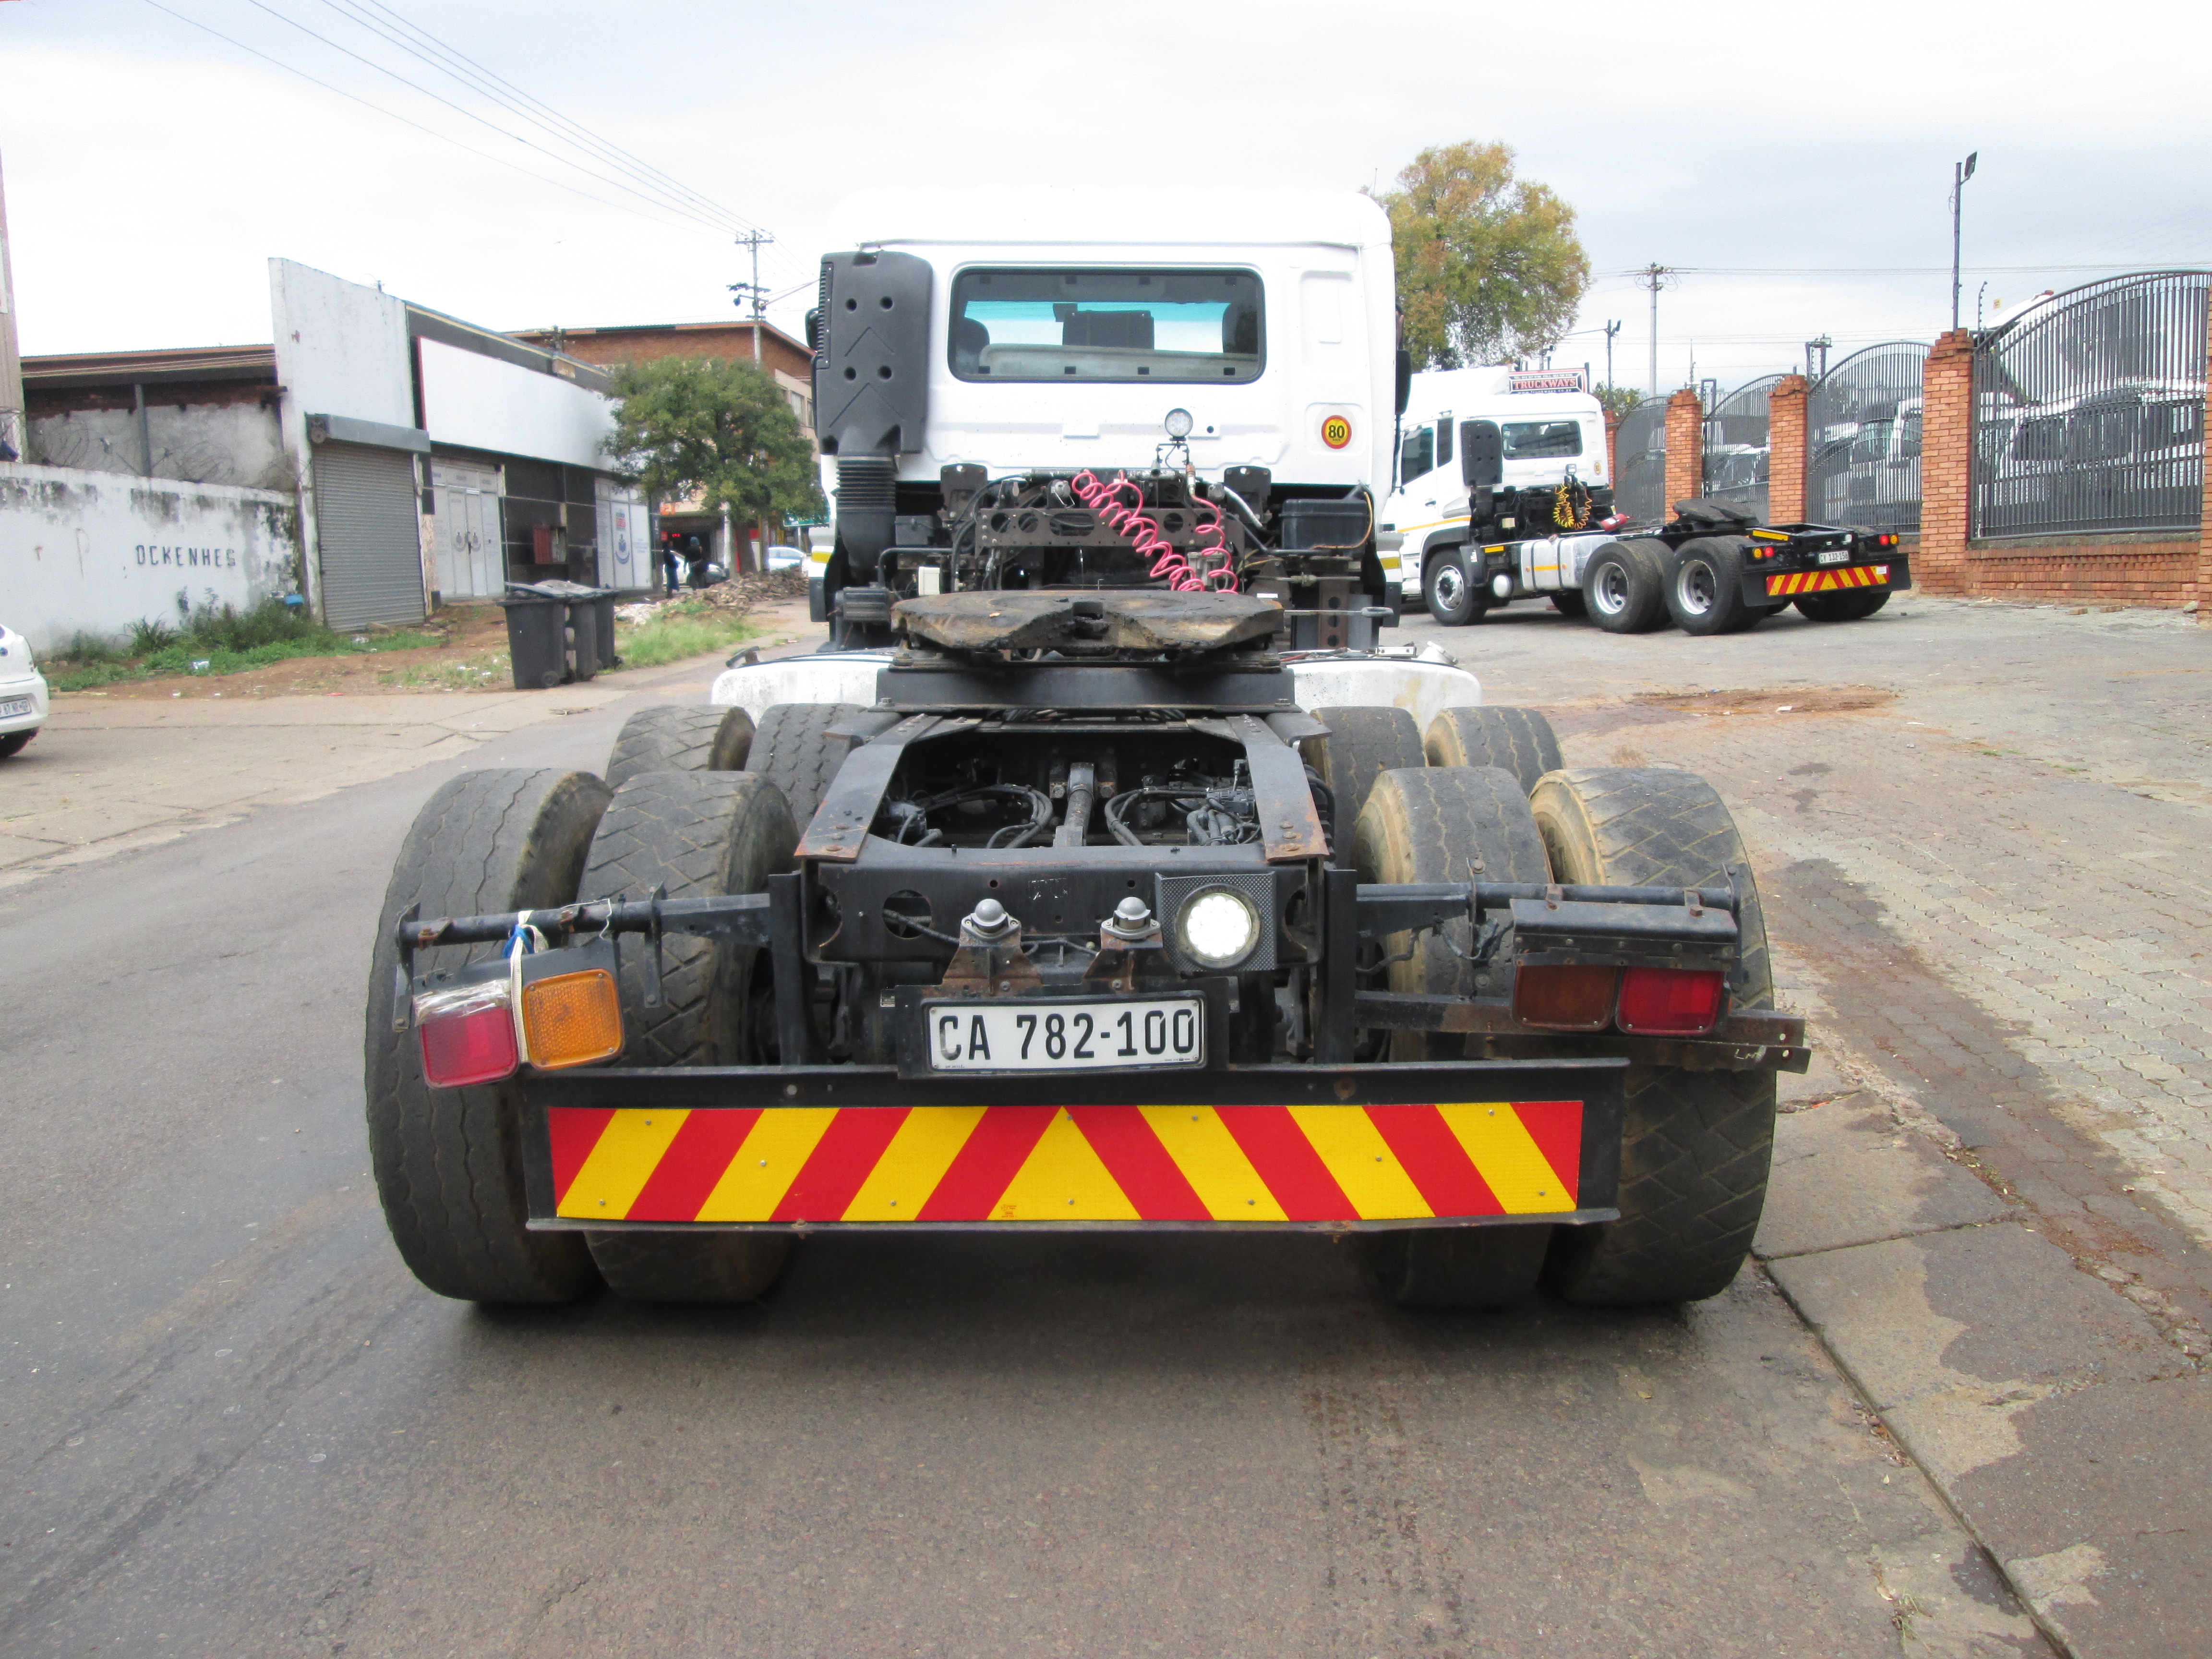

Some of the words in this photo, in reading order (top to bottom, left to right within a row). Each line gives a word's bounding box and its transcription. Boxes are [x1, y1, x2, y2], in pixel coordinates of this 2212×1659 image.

[1514, 378, 1576, 389] TRUCKWAYS
[1328, 425, 1345, 438] 80
[939, 1015, 991, 1060] CA
[1016, 1009, 1194, 1059] 782-100
